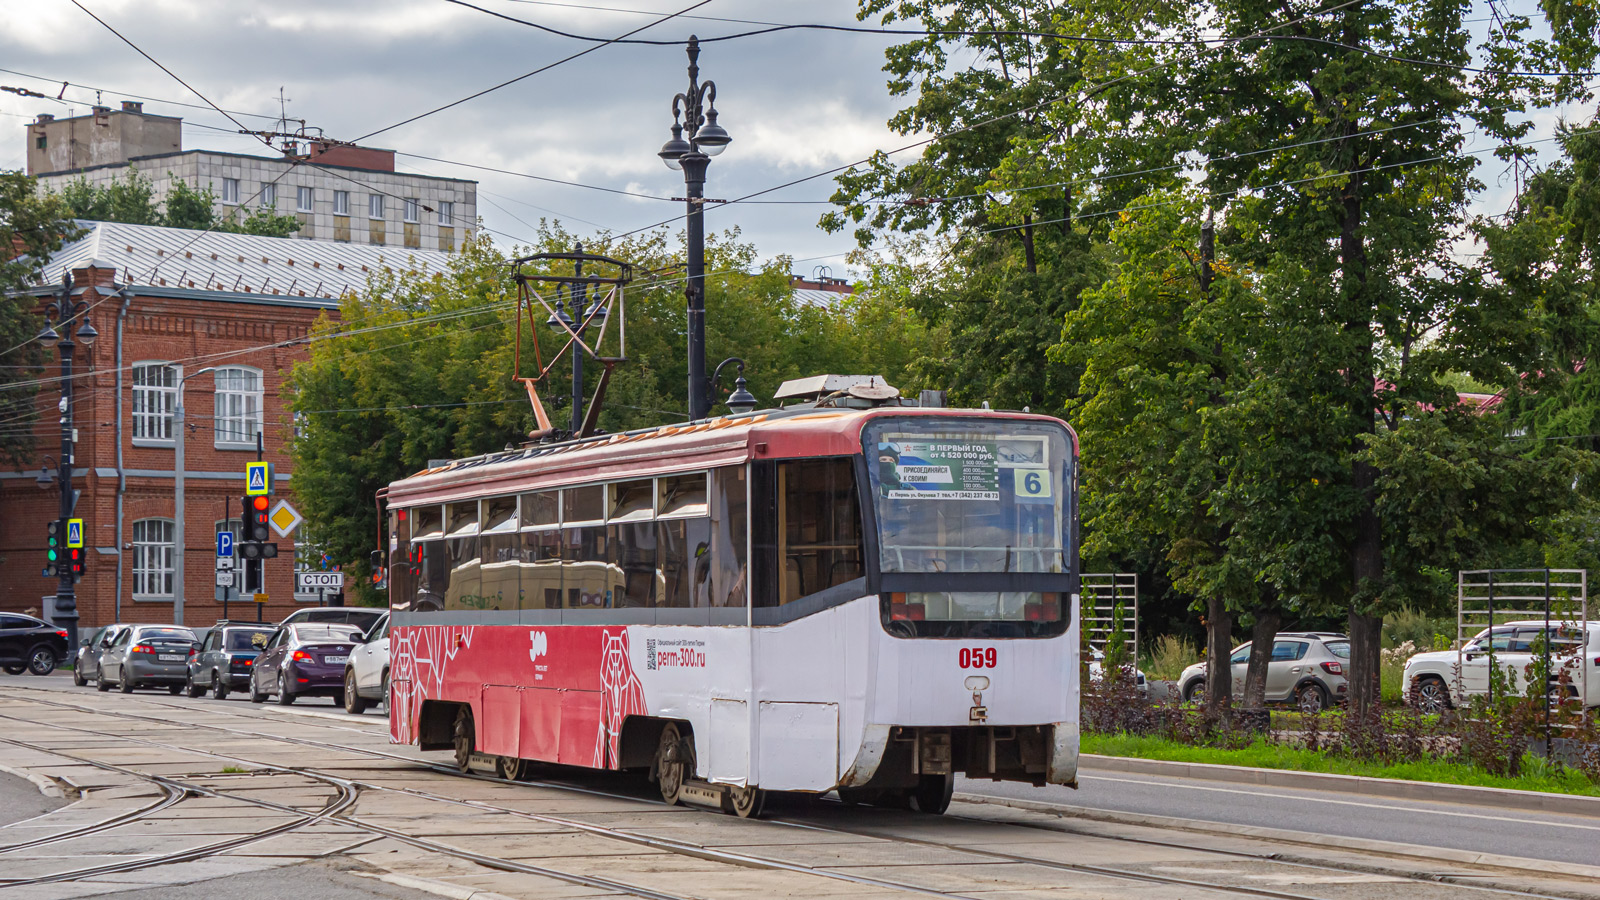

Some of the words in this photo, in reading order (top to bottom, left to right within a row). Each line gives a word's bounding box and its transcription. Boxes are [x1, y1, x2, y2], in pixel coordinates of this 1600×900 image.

[937, 444, 970, 452] ПЕРВЫЙ
[972, 445, 988, 453] ГОД
[1024, 472, 1042, 494] 6
[304, 575, 338, 584] СТОП
[658, 648, 706, 670] perm-300.ru
[958, 648, 997, 668] 059
